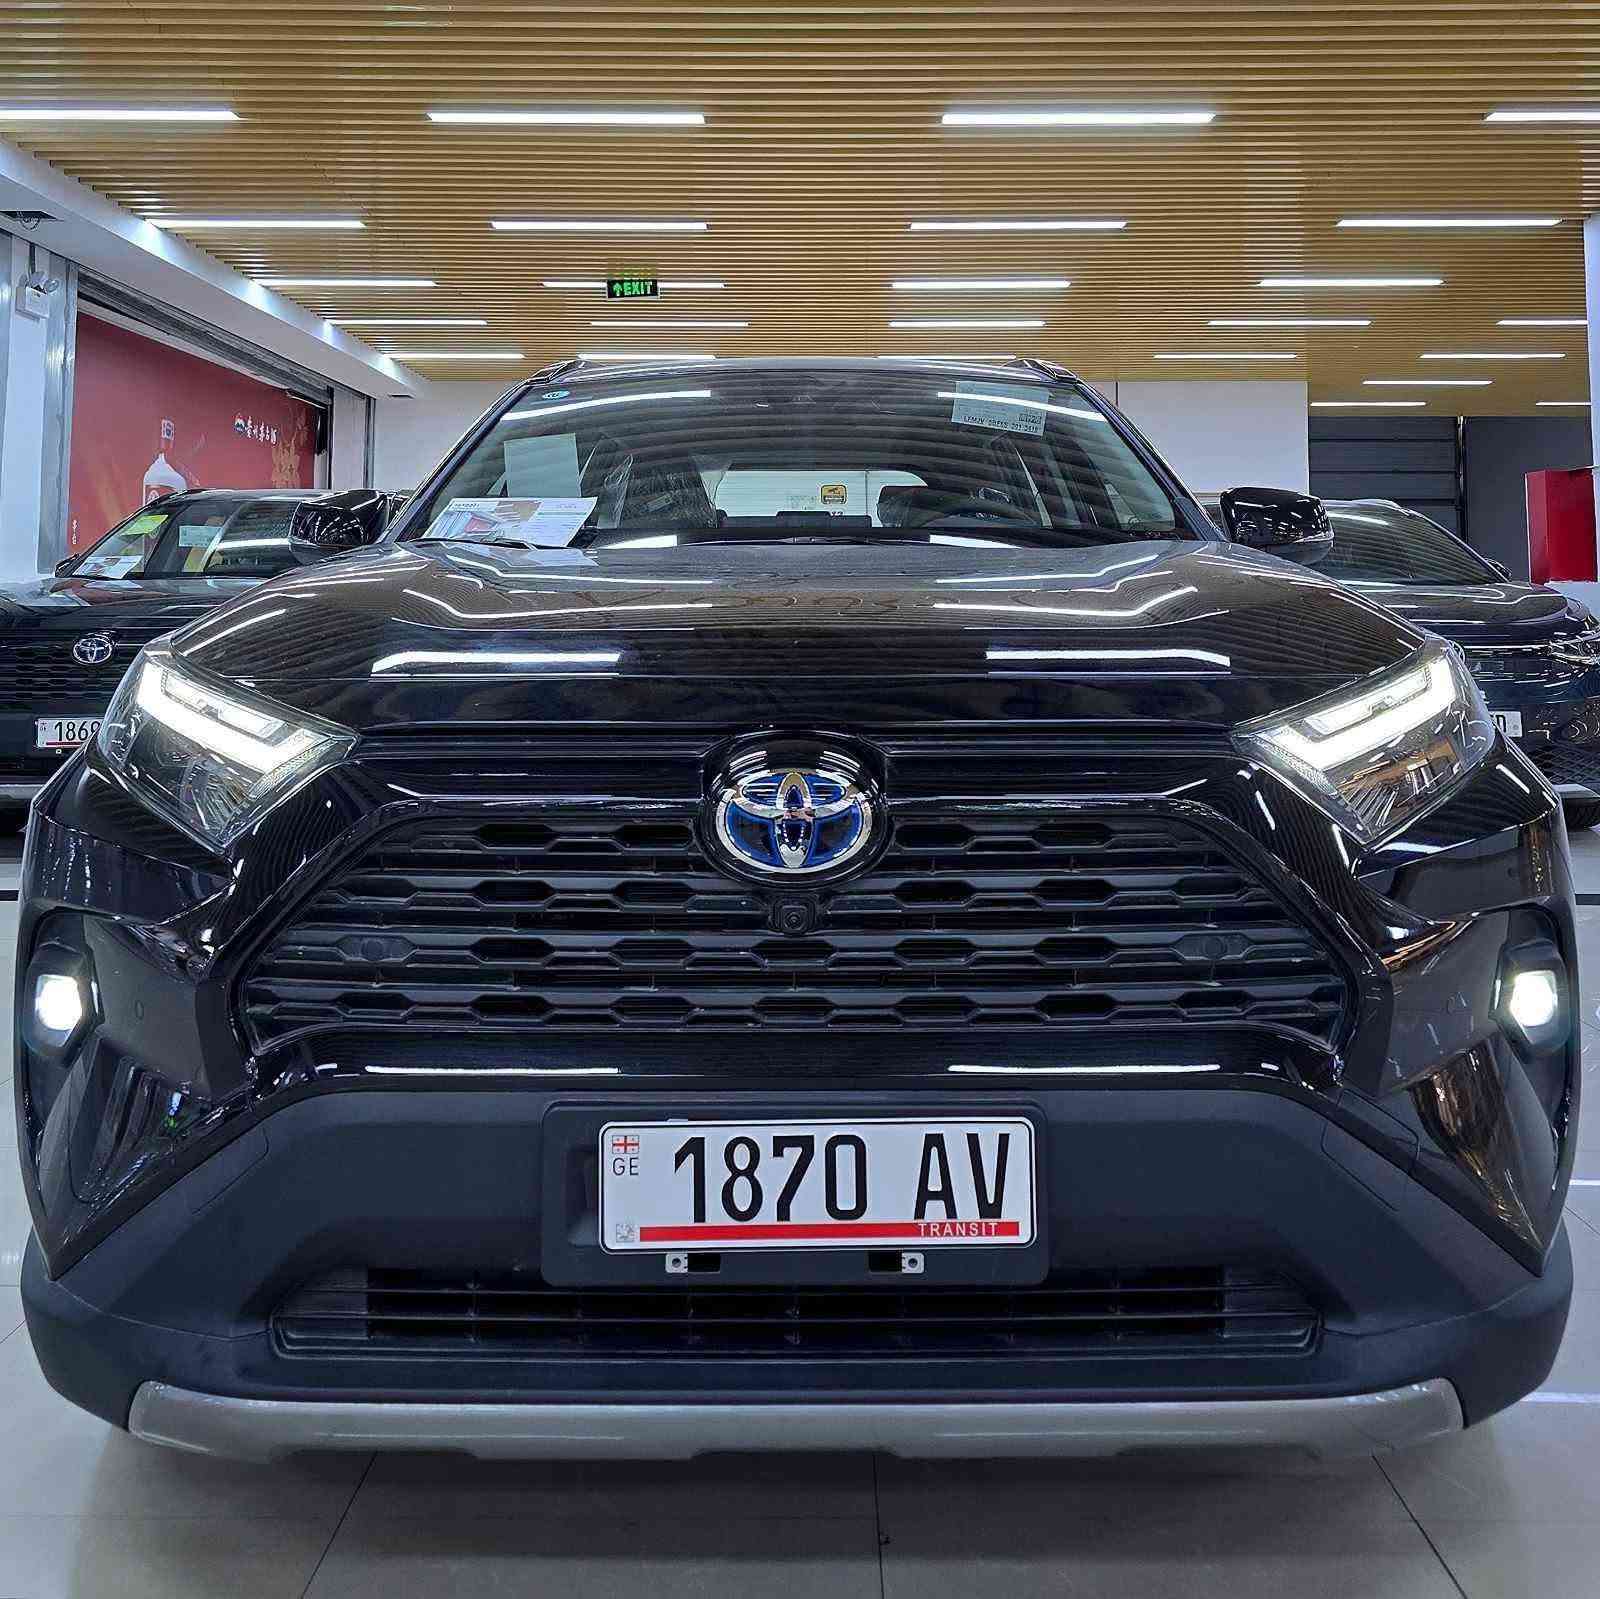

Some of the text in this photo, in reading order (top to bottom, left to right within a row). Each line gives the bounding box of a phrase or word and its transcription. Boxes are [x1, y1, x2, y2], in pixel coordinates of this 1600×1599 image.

[623, 281, 652, 295] EXIT
[612, 1157, 640, 1176] GE
[674, 1132, 1011, 1224] 1870 AV
[918, 1222, 999, 1238] TRANSIT
